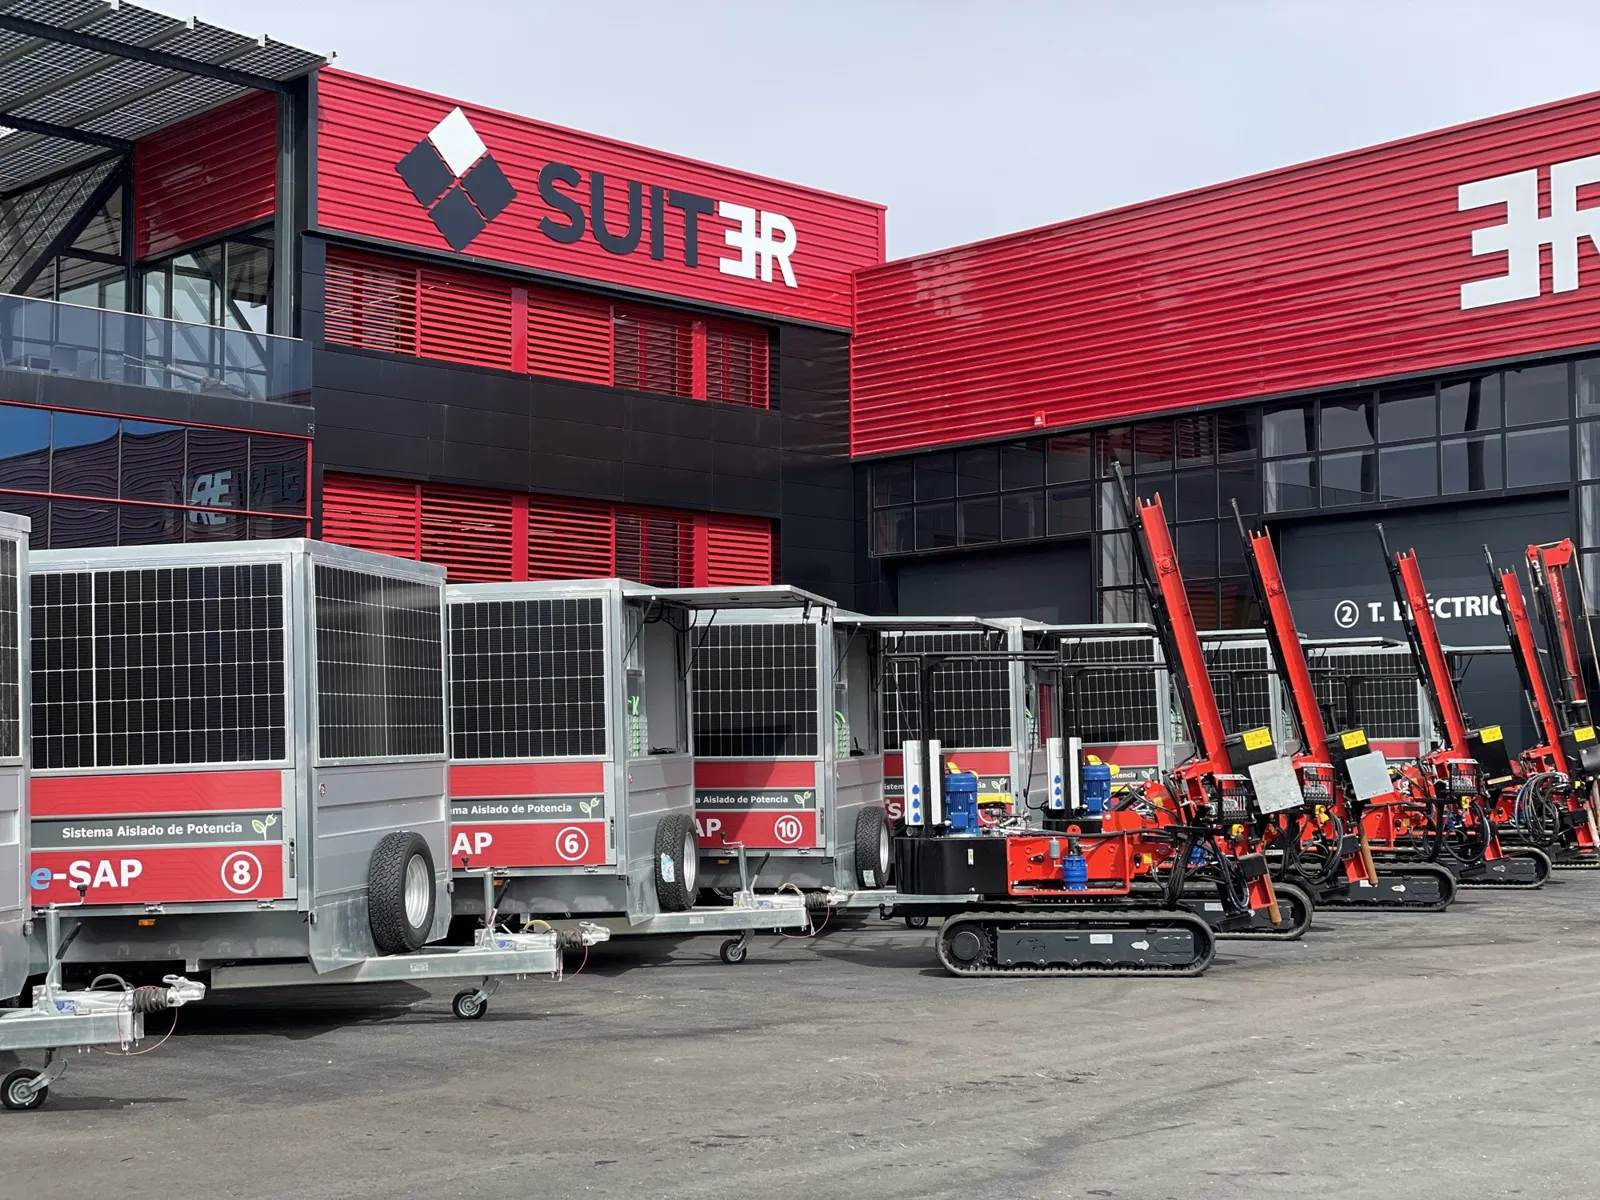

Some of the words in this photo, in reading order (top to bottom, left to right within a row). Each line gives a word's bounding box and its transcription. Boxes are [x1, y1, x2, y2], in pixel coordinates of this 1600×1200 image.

[537, 162, 798, 288] SUITER
[1367, 602, 1385, 622] T.
[1393, 593, 1526, 622] EÉCTRIC
[450, 807, 468, 815] ma
[471, 805, 509, 814] Aislado
[511, 804, 525, 813] de
[527, 803, 572, 813] Potencia
[703, 796, 735, 804] Aislado
[737, 795, 748, 803] de
[750, 795, 788, 803] Potencia
[62, 827, 113, 839] Sistema
[116, 825, 164, 837] Aislado
[167, 823, 184, 835] de
[187, 822, 243, 835] Potencia
[778, 821, 798, 838] 10
[564, 833, 579, 854] 6
[31, 859, 143, 890] e-SAP
[232, 860, 251, 885] 8
